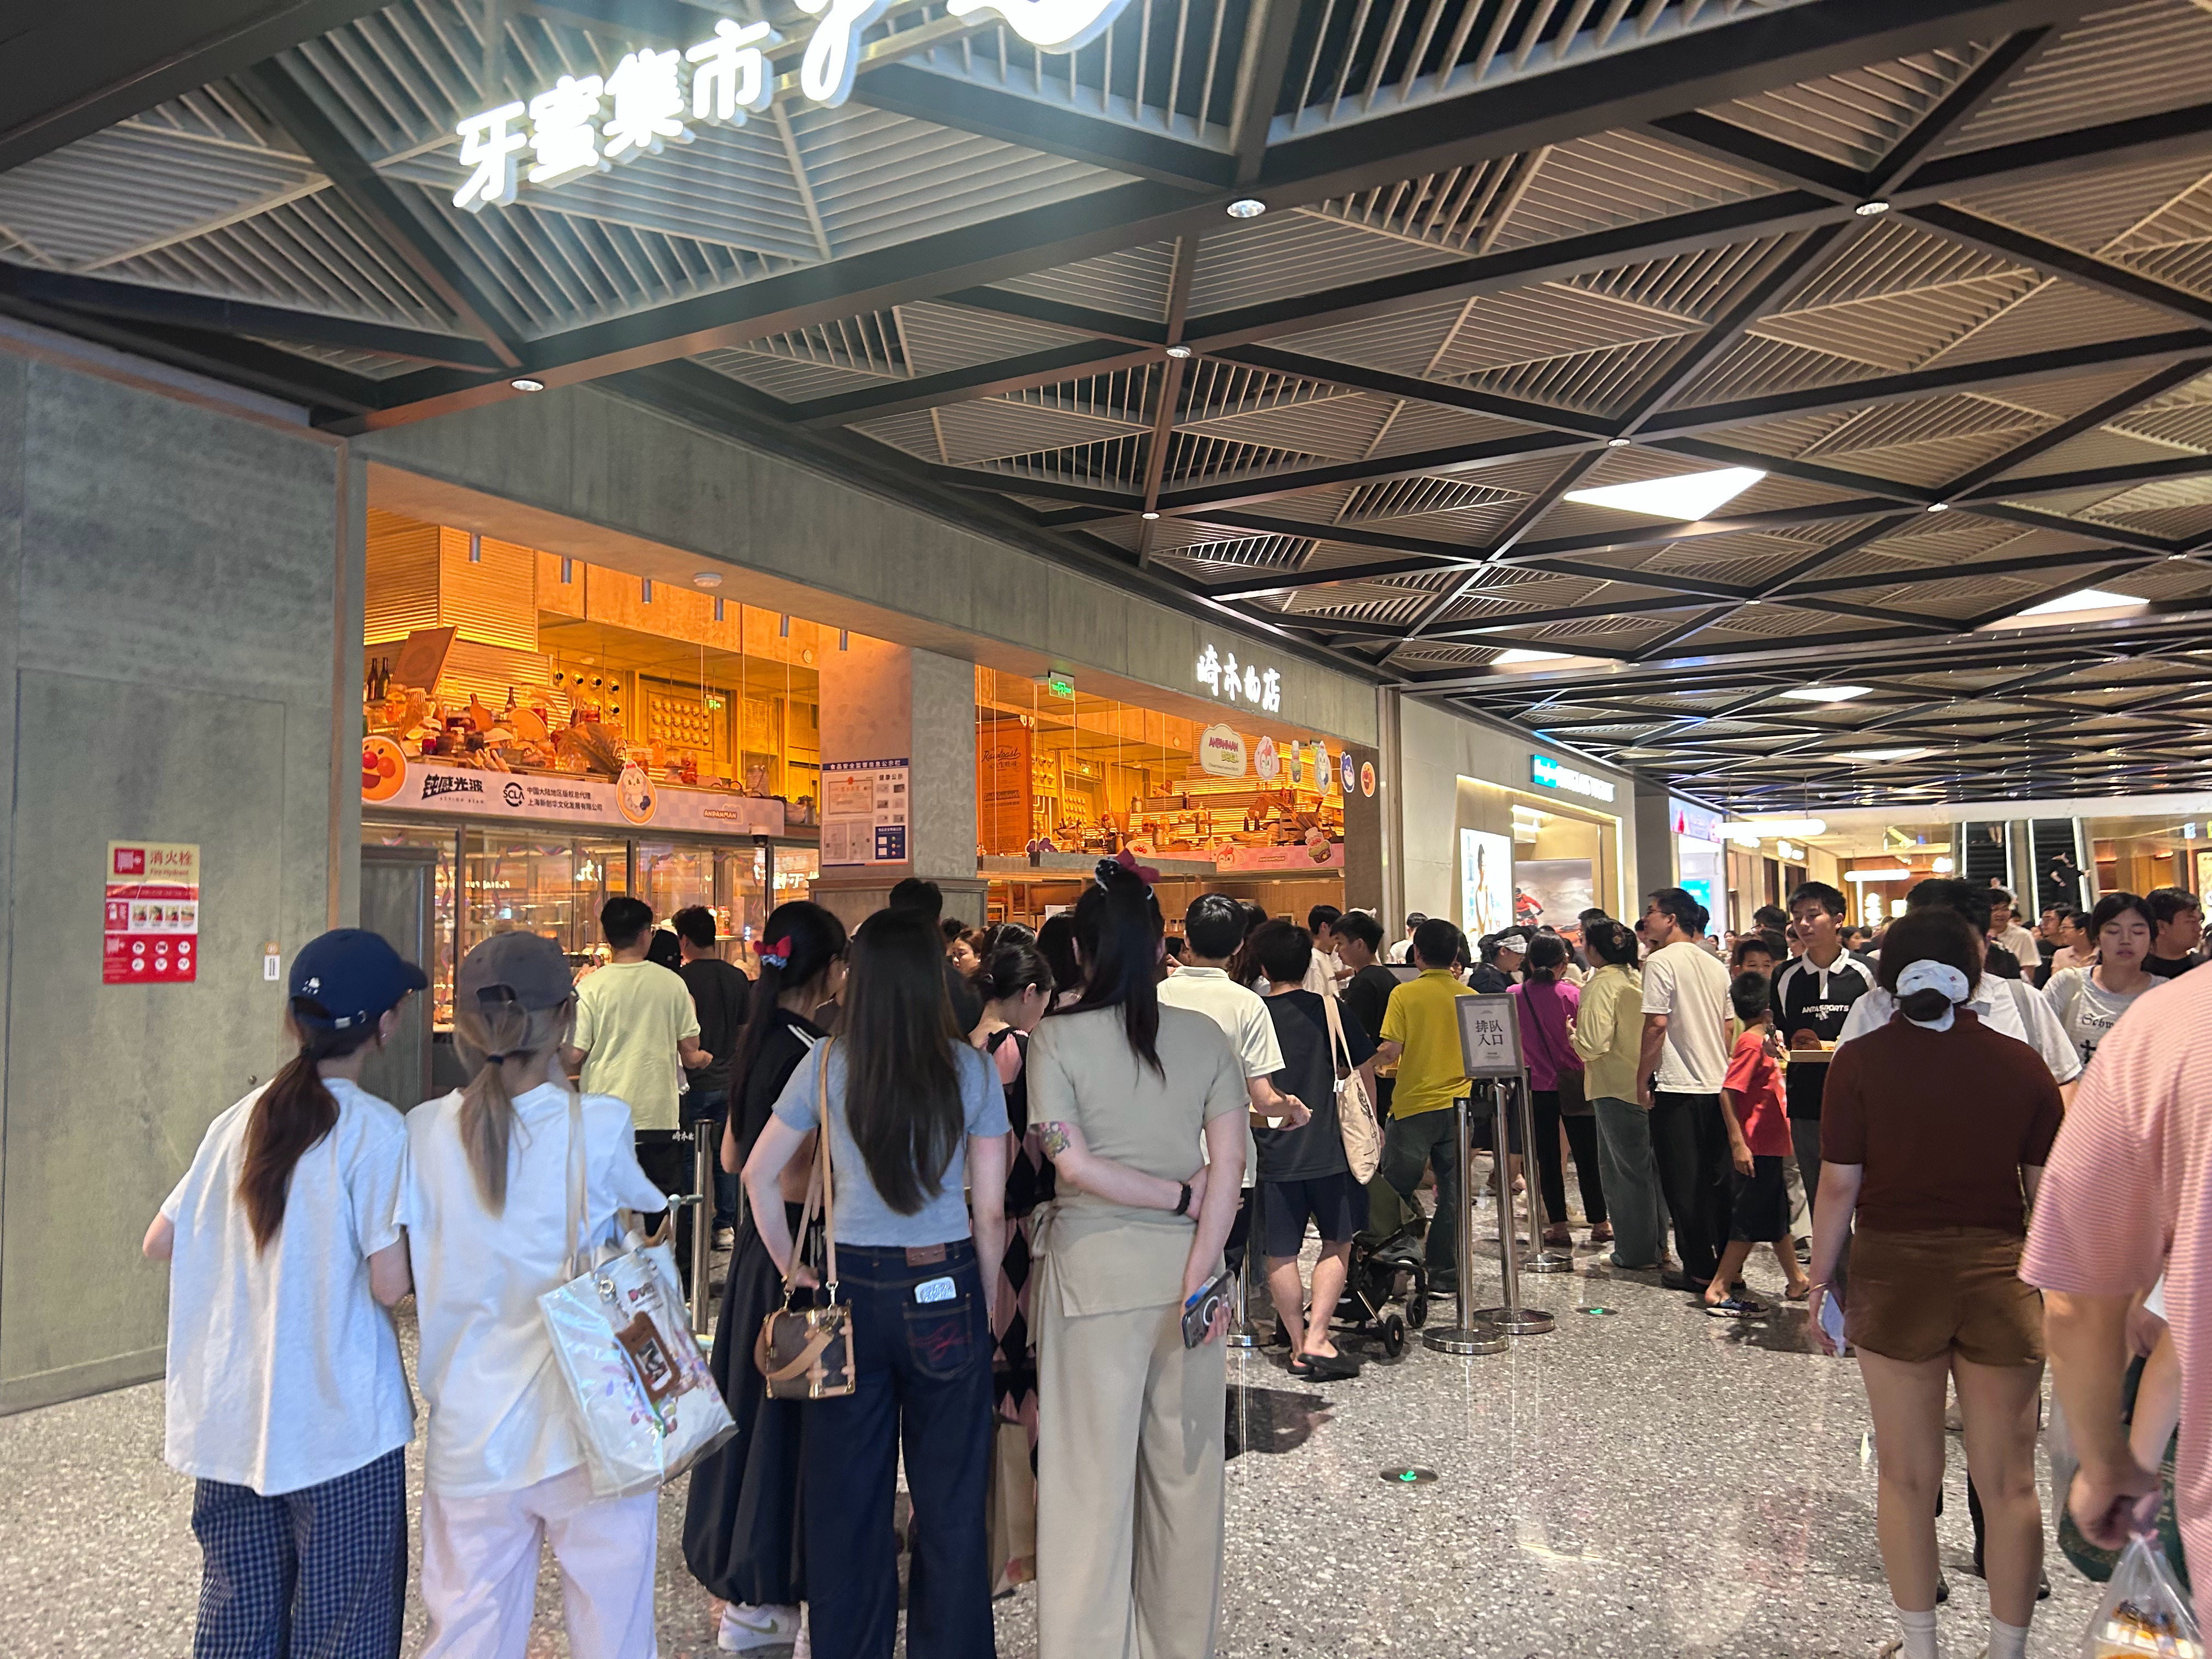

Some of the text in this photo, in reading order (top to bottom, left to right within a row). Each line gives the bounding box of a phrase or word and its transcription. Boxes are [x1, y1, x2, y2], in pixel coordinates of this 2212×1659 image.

[453, 18, 771, 208] 牙蜜集市
[503, 790, 524, 799] SCLA
[527, 787, 591, 799] 中国大陆地区版权总代理
[528, 798, 602, 811] 上海新创华文化发展有限公司
[704, 809, 737, 819] ANPANMAN
[150, 850, 193, 866] 消火栓
[1475, 1020, 1503, 1032] 排队
[1478, 1034, 1503, 1045] 入口
